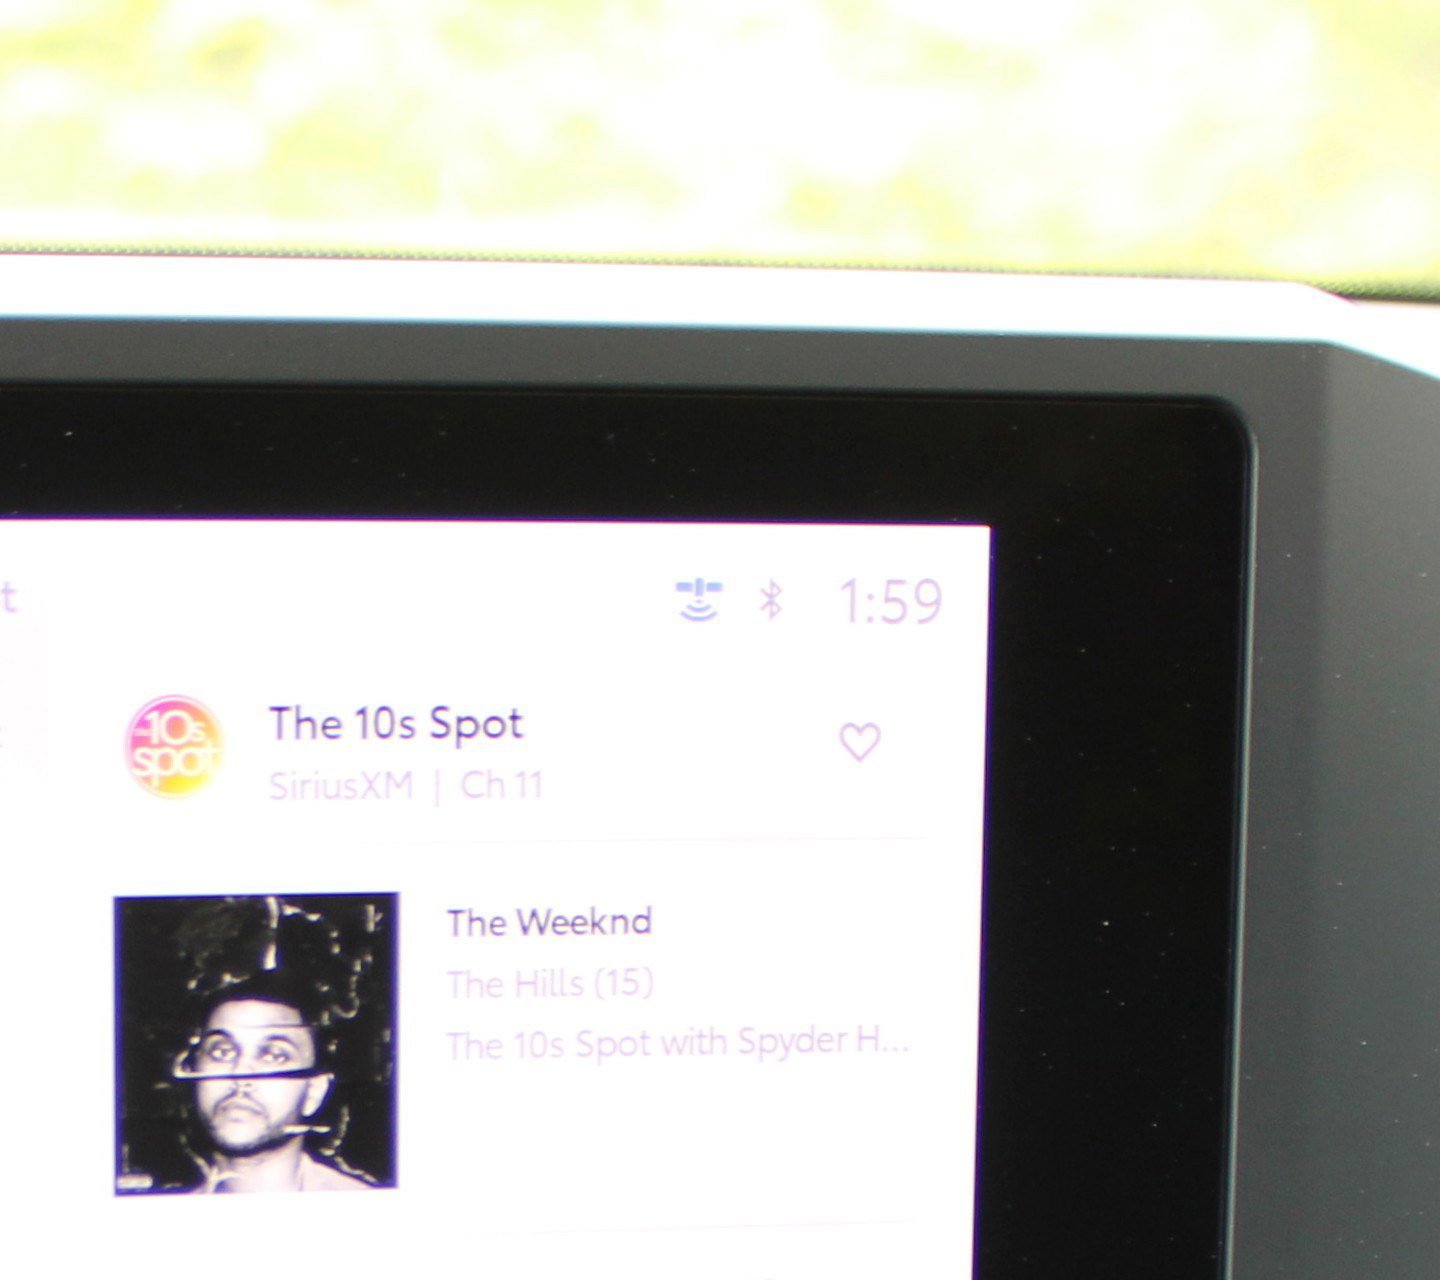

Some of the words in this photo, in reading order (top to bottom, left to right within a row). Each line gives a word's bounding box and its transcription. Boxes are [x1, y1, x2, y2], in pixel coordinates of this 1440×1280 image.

[840, 577, 943, 626] 1:59
[267, 704, 344, 741] The
[354, 704, 417, 741] 10s
[429, 704, 524, 750] Spot
[269, 769, 414, 802] SiriusXM
[459, 768, 506, 800] Ch
[513, 769, 543, 800] 11
[446, 907, 508, 938] The
[515, 905, 653, 937] Weeknd
[445, 968, 505, 1000] The
[514, 967, 586, 999] Hills
[593, 965, 655, 1001] (15)
[445, 1030, 505, 1061] The
[513, 1029, 566, 1060] 10s
[575, 1028, 652, 1066] Spot
[659, 1025, 729, 1057] with
[737, 1023, 850, 1064] Spyder
